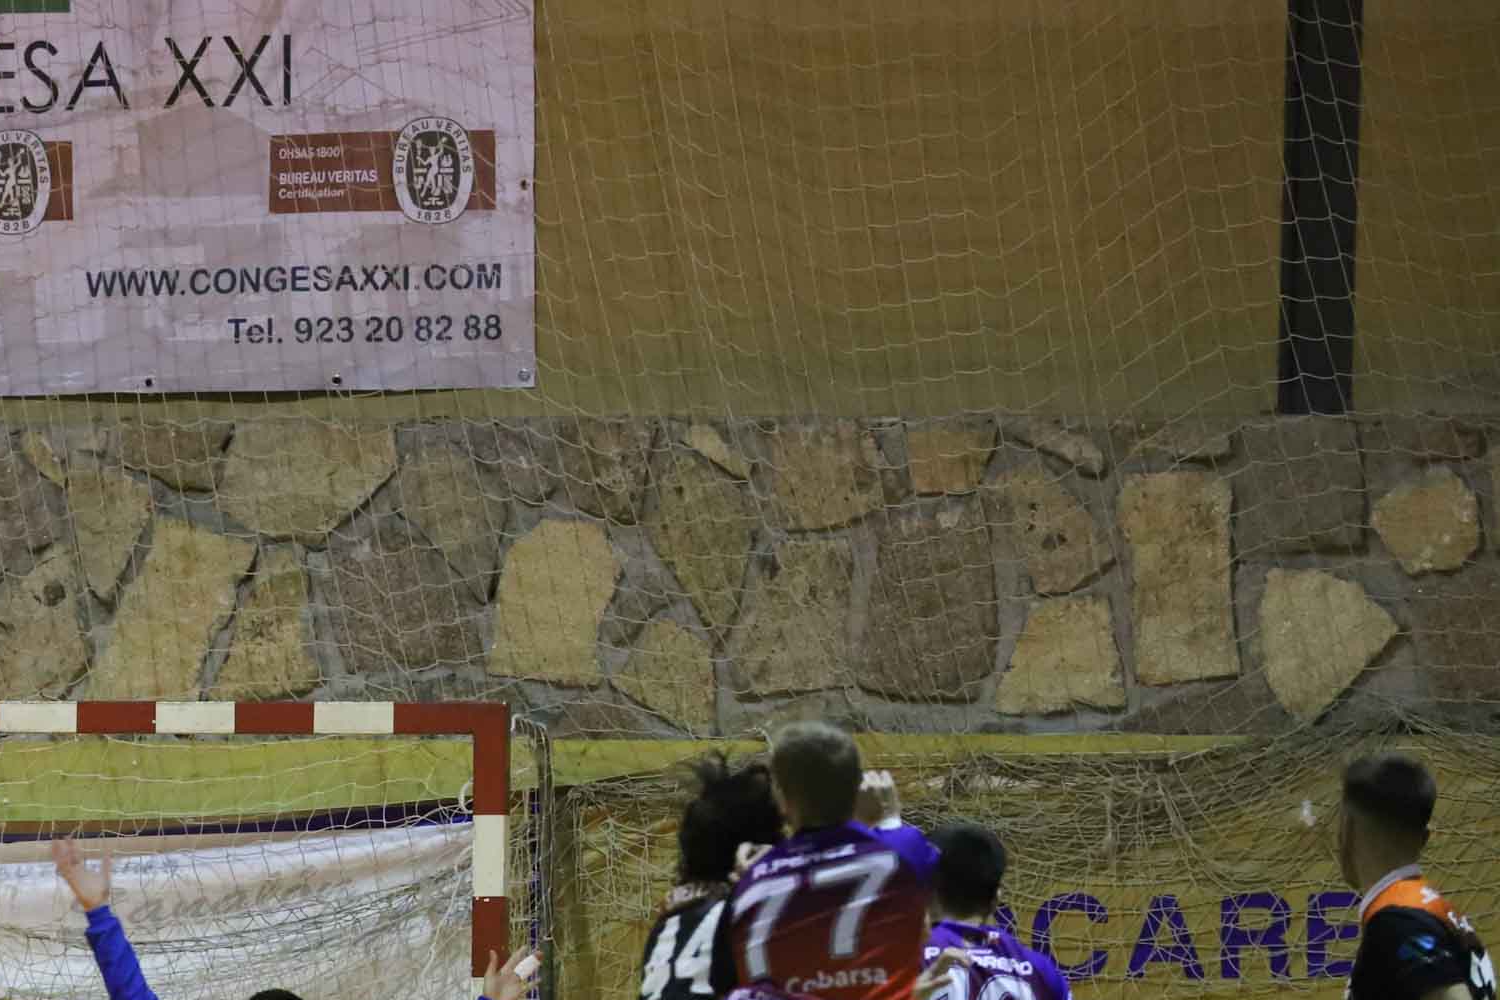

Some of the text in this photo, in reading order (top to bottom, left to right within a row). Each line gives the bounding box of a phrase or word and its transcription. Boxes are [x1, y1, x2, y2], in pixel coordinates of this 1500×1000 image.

[164, 34, 292, 109] XXI
[278, 187, 344, 199] Certification
[279, 169, 378, 185] BUREAU VERITAS
[86, 263, 502, 297] WWW.CONGESAXXI.COM
[227, 313, 503, 344] Tel. 923 20 82 88
[731, 852, 898, 982] 77
